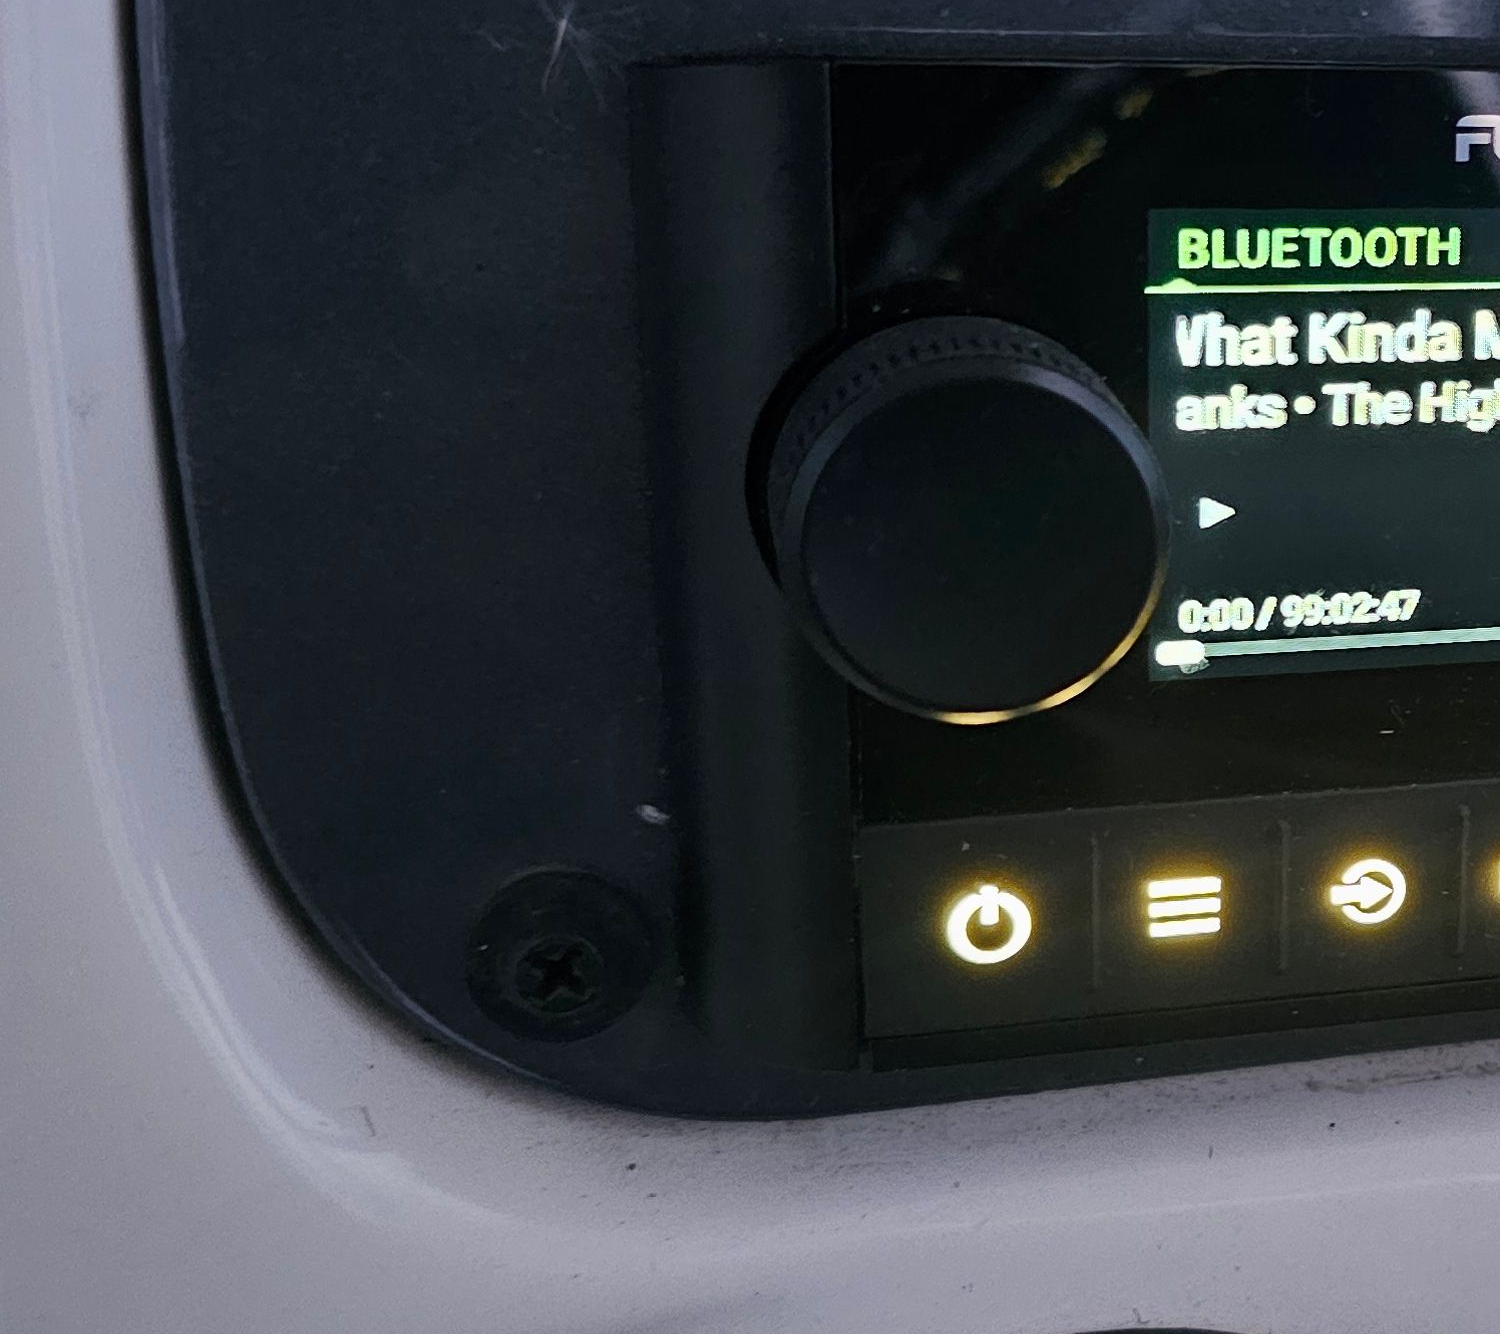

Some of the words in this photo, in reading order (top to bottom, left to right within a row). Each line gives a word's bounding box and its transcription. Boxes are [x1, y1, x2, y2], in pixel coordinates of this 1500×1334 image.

[1177, 226, 1462, 270] BLUETOOTH
[1308, 308, 1463, 365] Kinda
[1175, 383, 1288, 431] anks
[1322, 381, 1412, 426] The
[1177, 597, 1254, 633] 0:00
